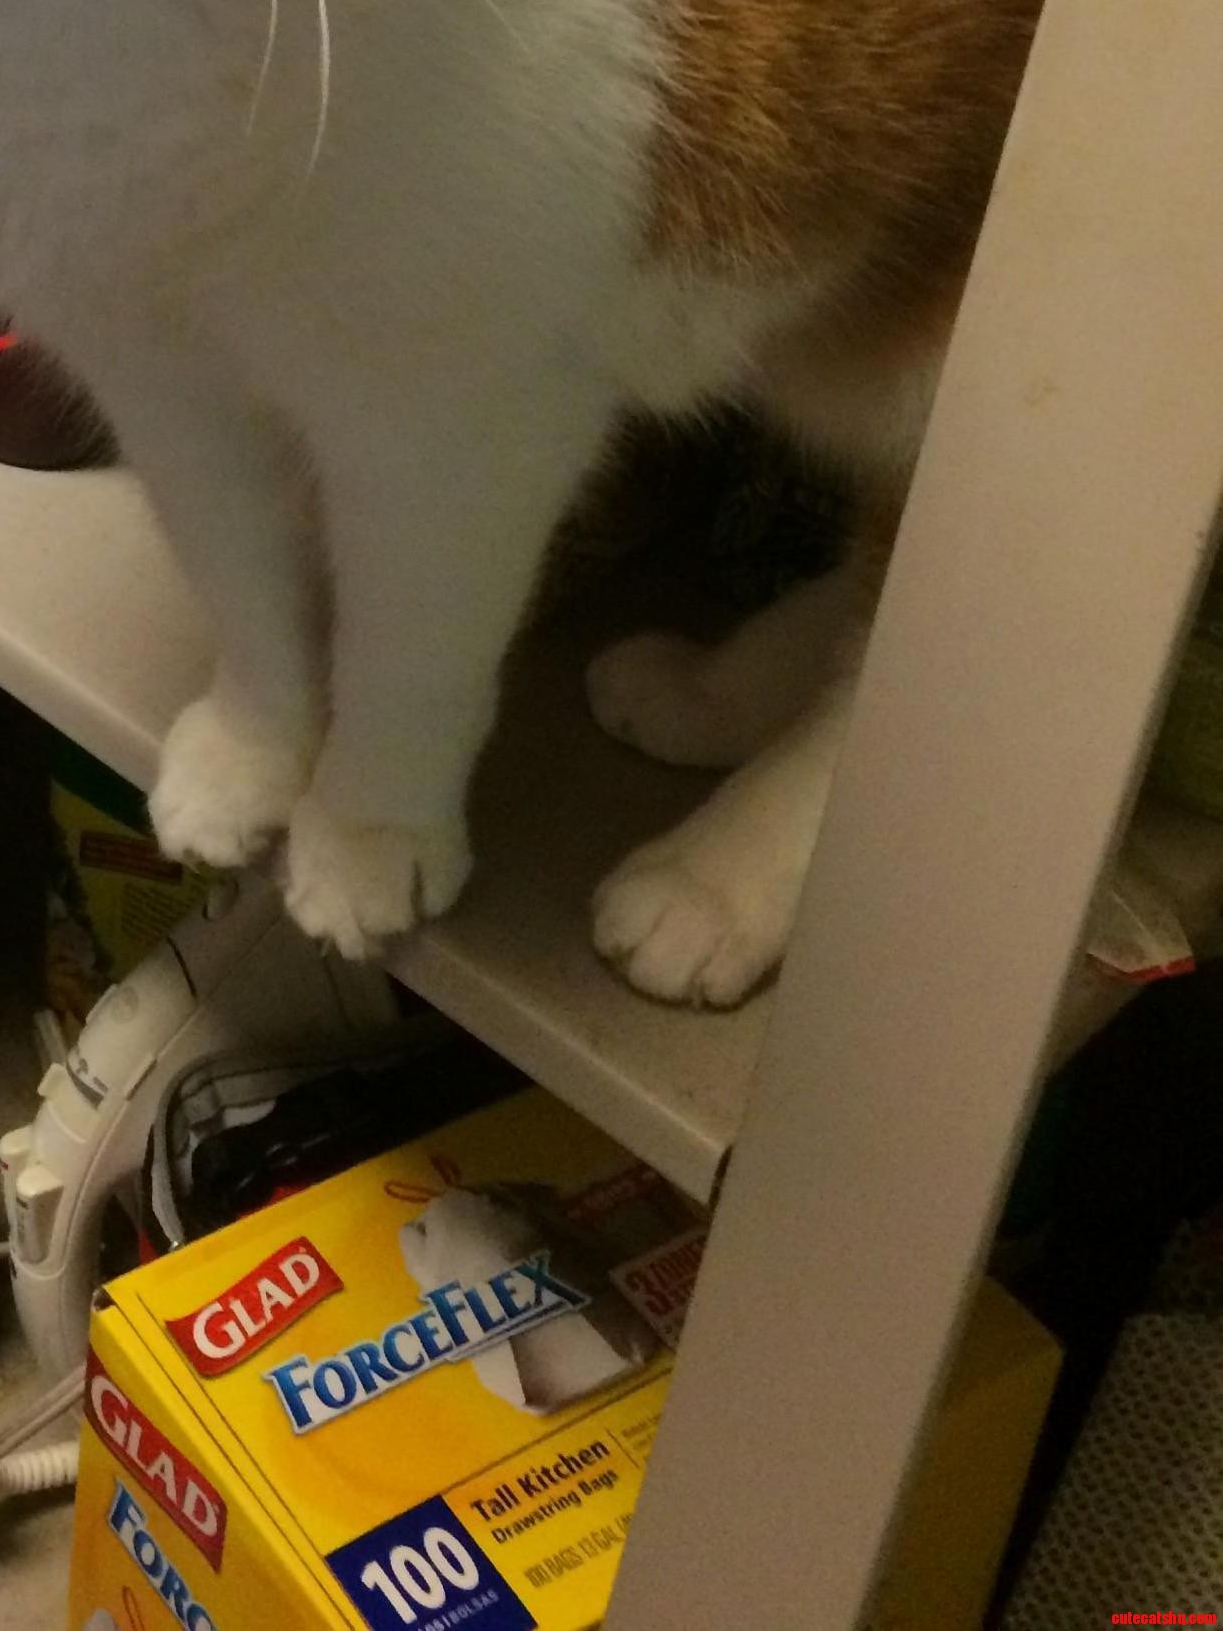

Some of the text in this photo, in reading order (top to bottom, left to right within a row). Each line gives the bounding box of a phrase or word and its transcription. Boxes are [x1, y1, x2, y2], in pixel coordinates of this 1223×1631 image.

[192, 1250, 321, 1360] GLAD
[90, 1373, 219, 1539] GLAD
[470, 1439, 612, 1523] Tall Kitchen
[490, 1468, 620, 1545] Drawstring Bags
[108, 1477, 218, 1631] FORC
[360, 1526, 480, 1625] 100
